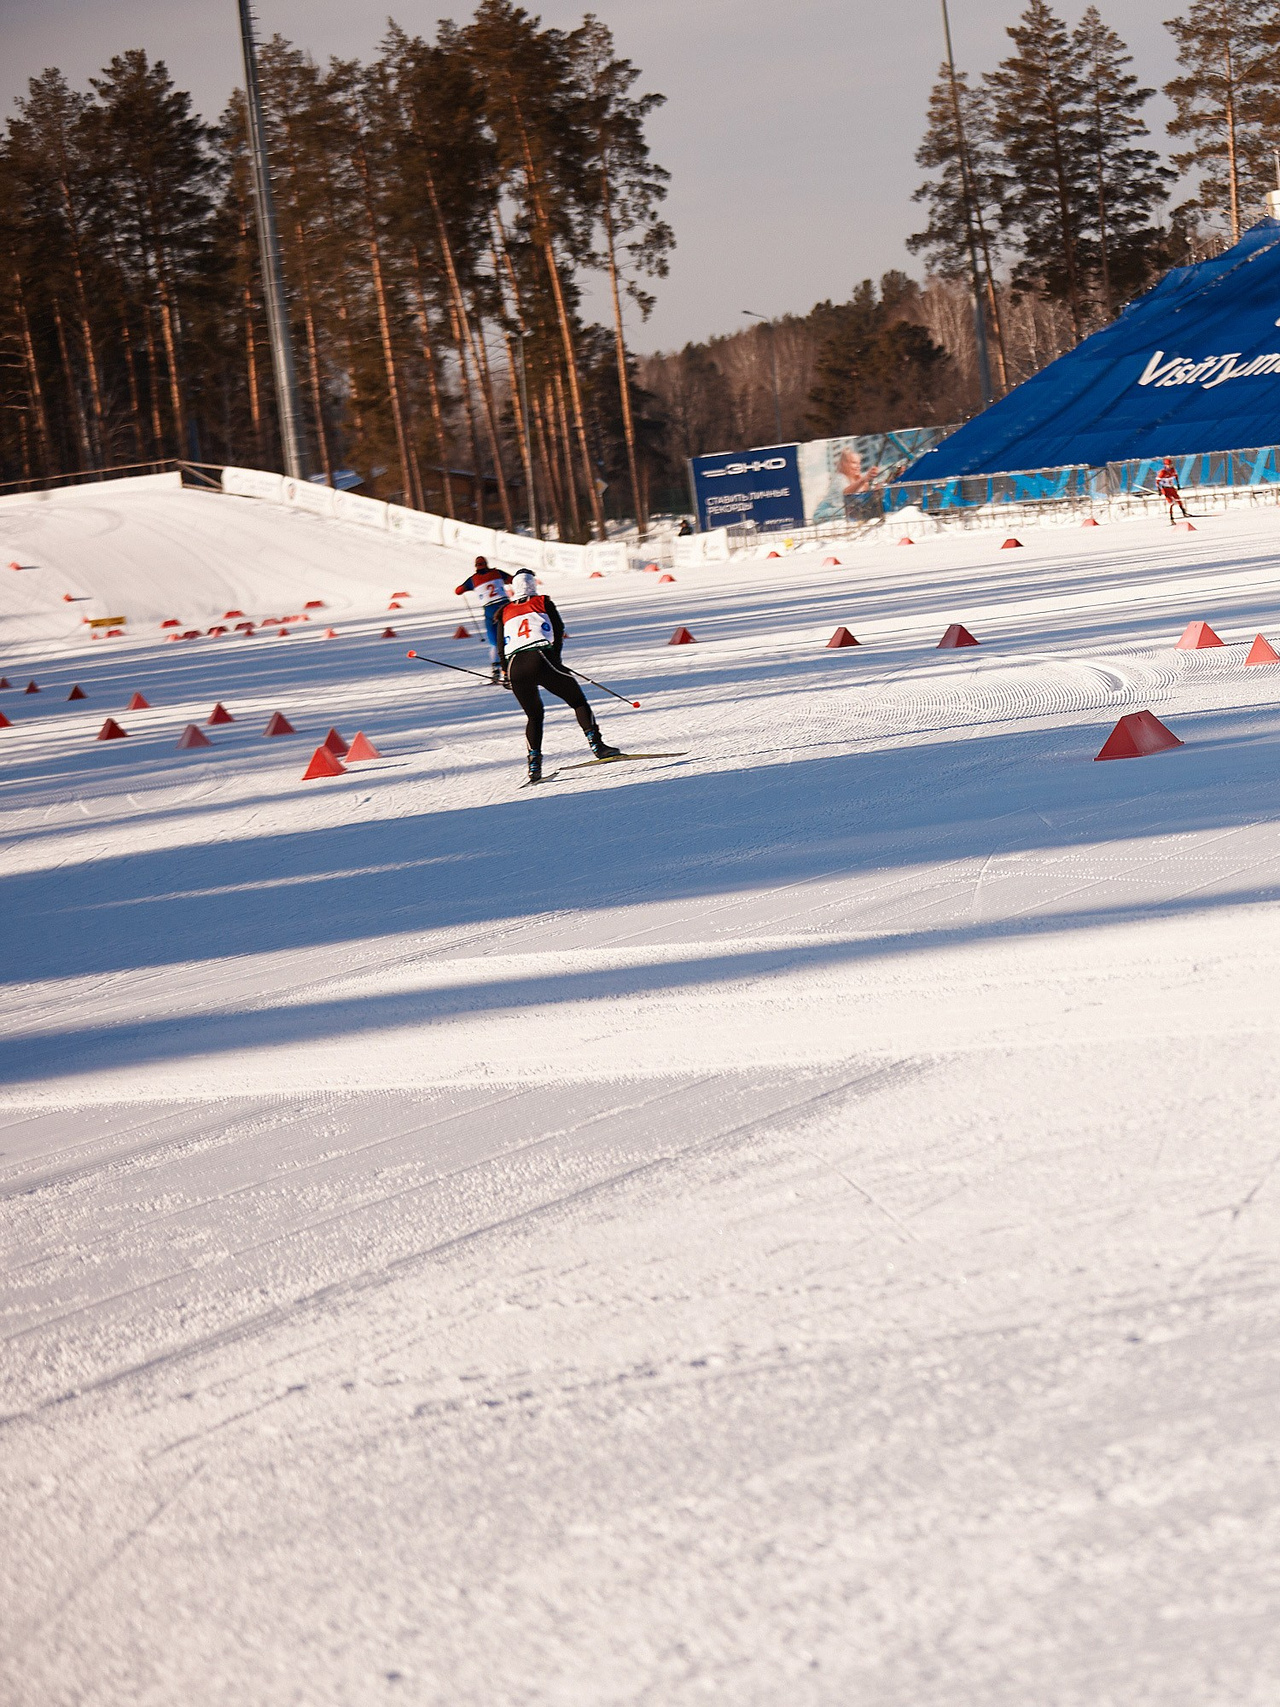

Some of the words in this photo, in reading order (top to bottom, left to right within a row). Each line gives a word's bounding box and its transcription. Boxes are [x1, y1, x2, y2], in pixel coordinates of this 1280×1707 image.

[706, 494, 749, 506] СТАВИТЬ
[749, 488, 790, 501] ЛИЧНЫЕ
[707, 502, 753, 514] РЕКОРДЫ
[487, 584, 497, 598] 2
[518, 619, 532, 639] 4
